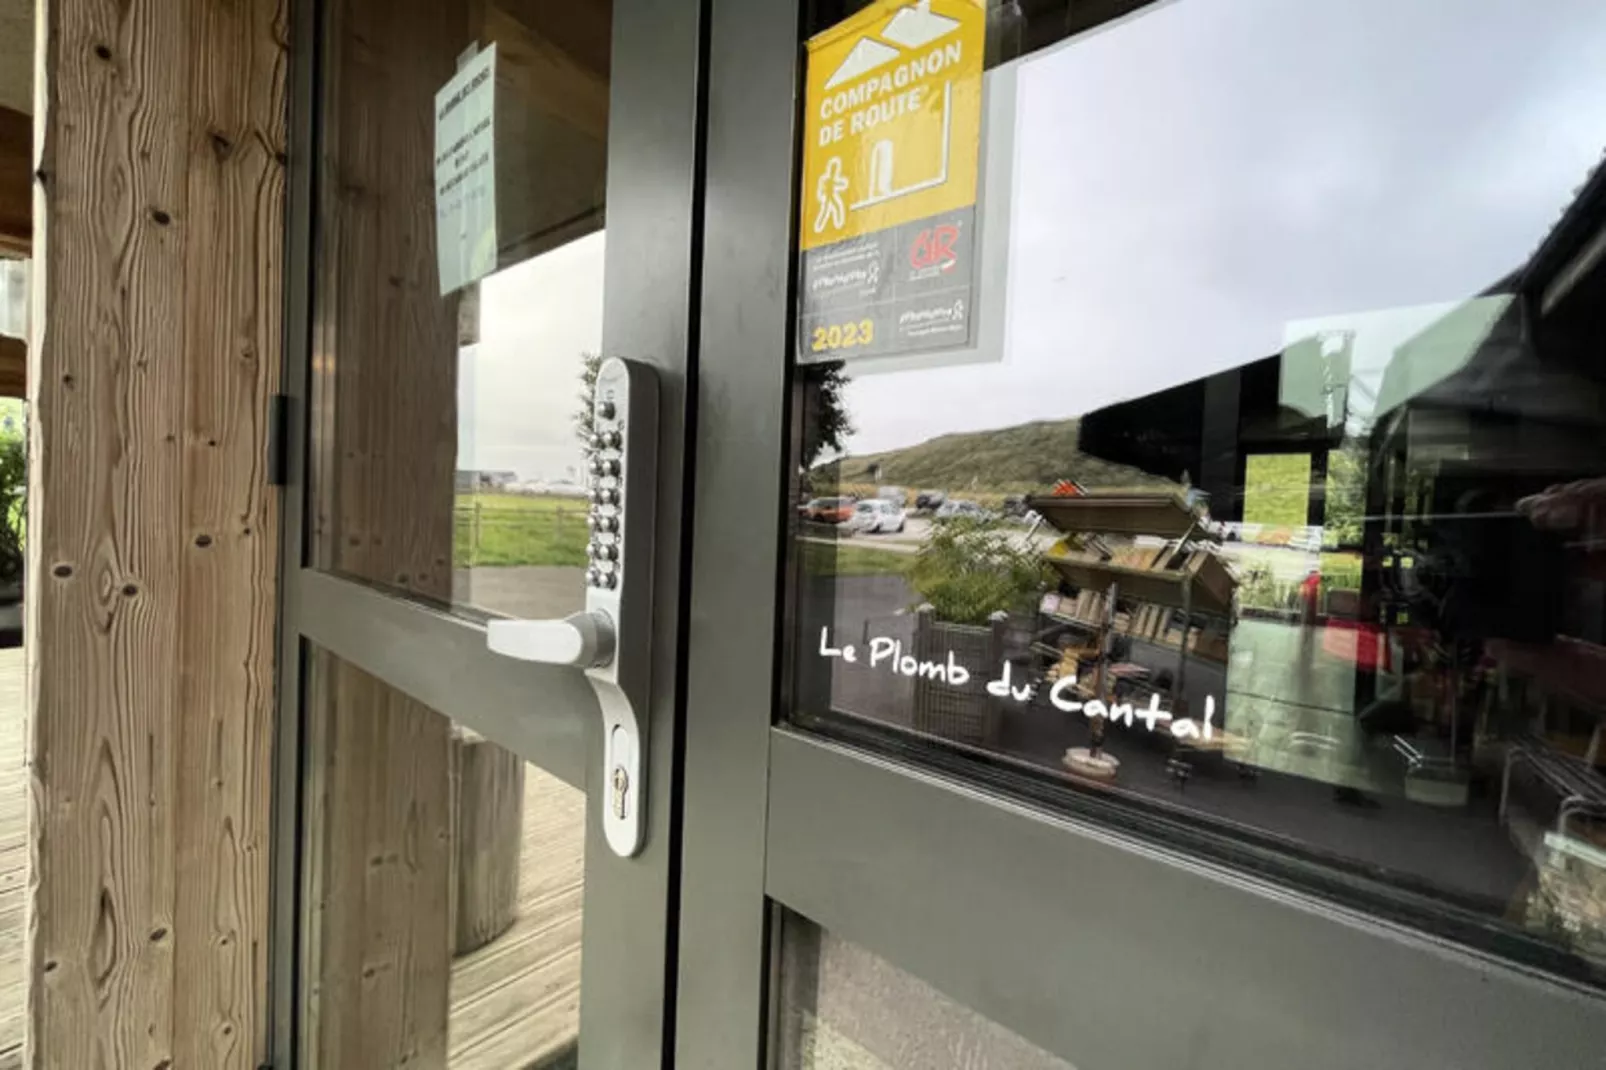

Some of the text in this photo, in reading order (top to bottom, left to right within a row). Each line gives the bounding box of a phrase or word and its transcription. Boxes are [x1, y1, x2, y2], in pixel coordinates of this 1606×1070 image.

[819, 40, 963, 120] COMPAGNON
[818, 120, 845, 147] DE
[812, 318, 873, 352] 2023
[819, 625, 1215, 740] Le Plomb du Cantal
